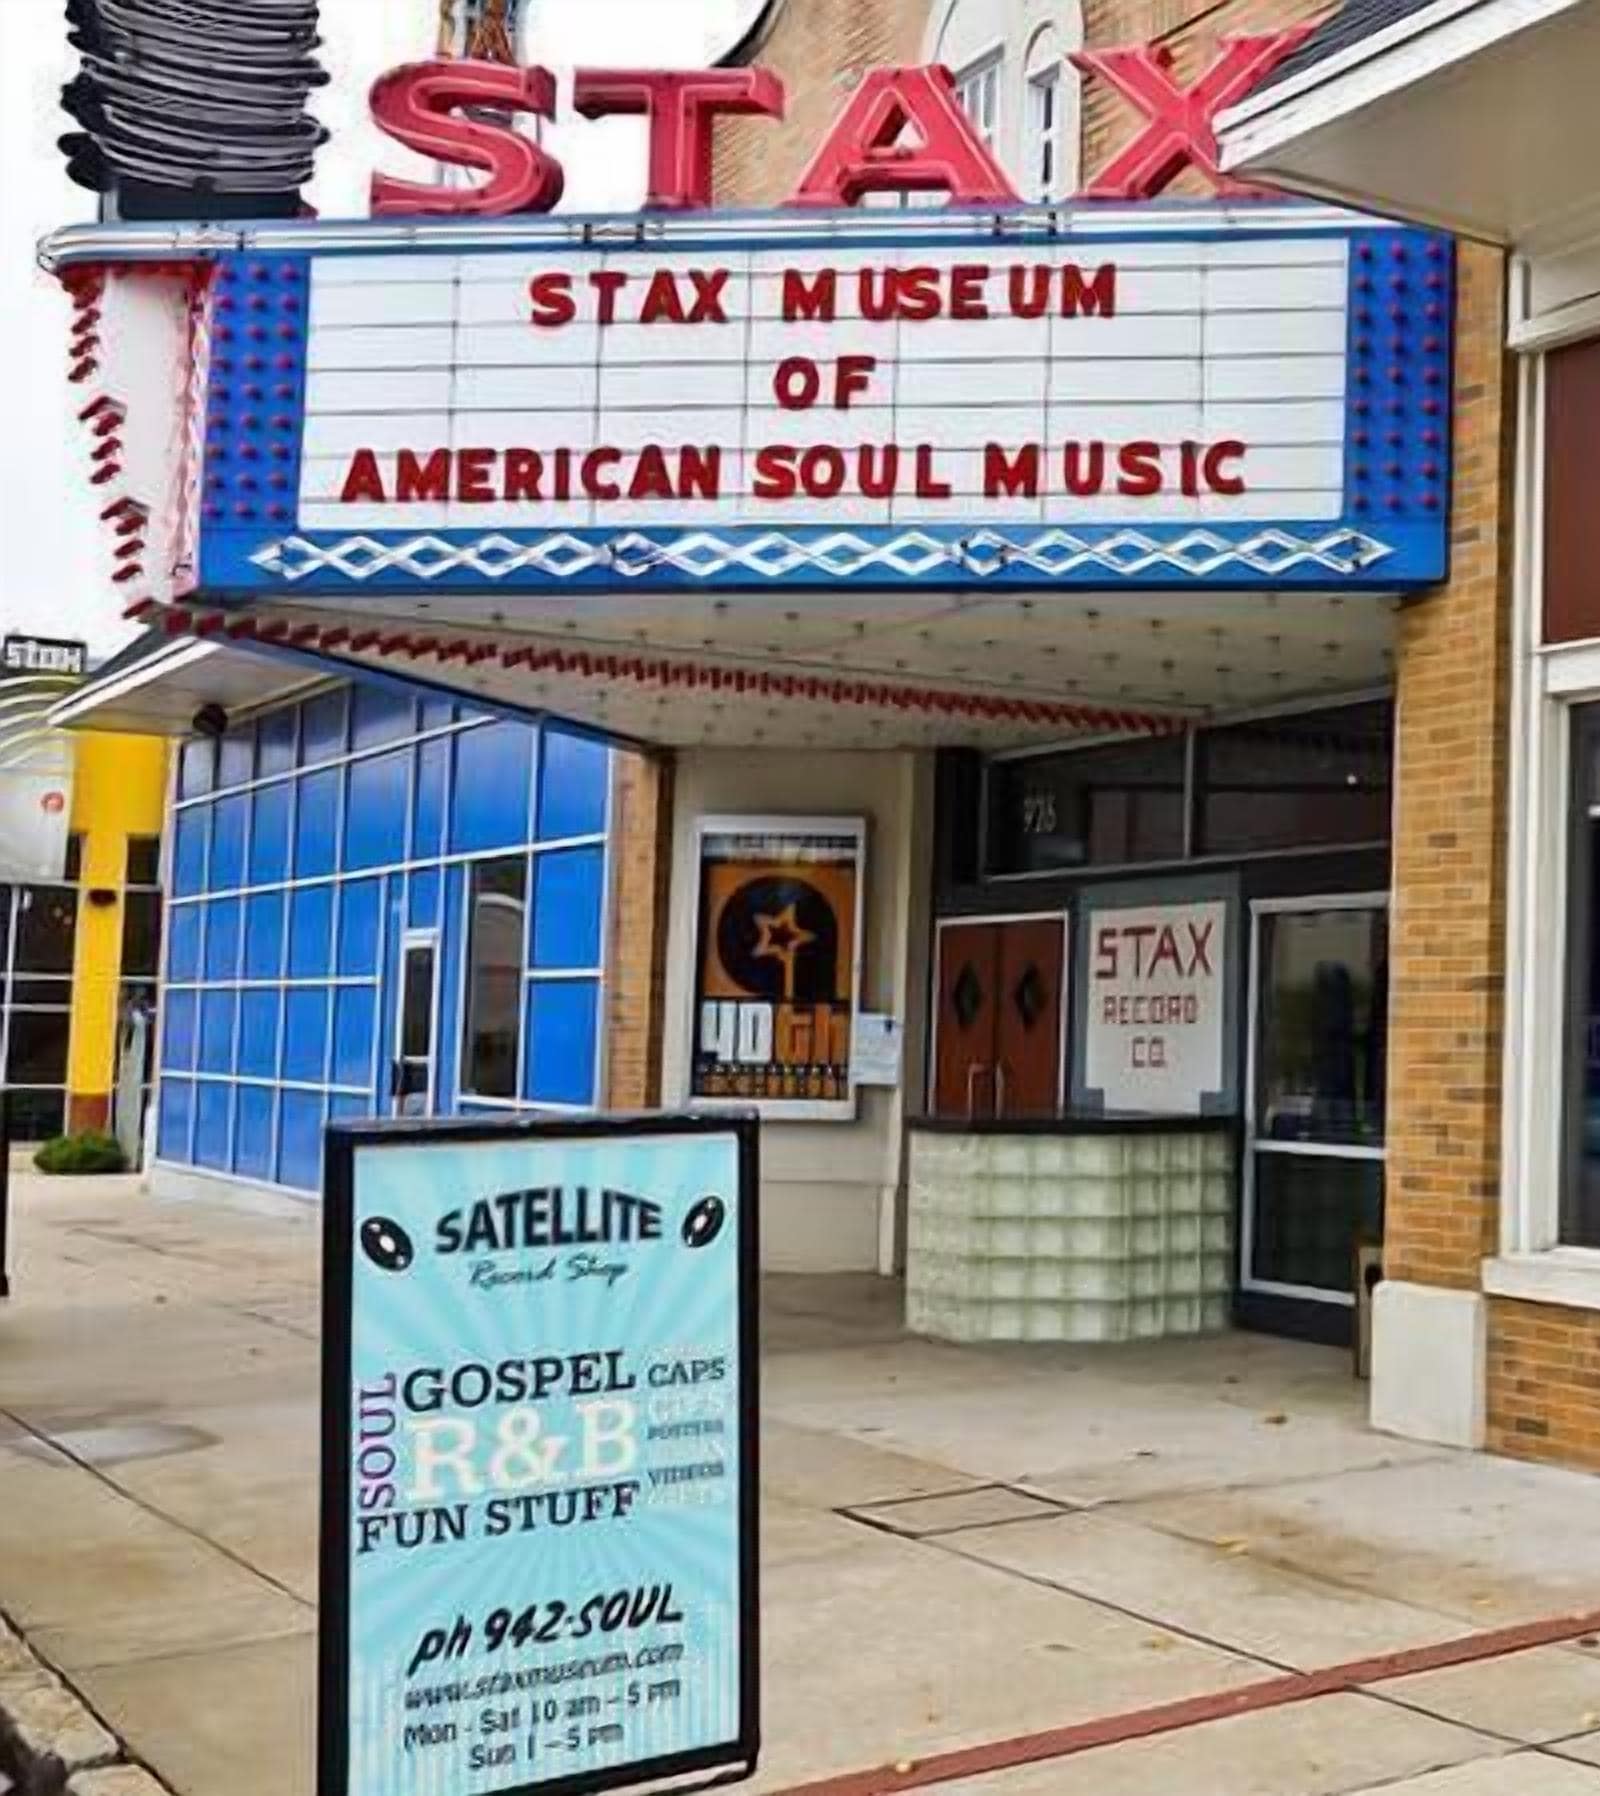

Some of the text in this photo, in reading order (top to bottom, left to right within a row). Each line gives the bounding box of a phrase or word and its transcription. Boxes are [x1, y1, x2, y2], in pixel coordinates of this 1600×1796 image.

[368, 20, 1322, 213] STAX
[529, 263, 1117, 327] STAX MUSEUM
[773, 355, 876, 412] OF
[340, 441, 1247, 503] AMERICAN SOUL MUSIC
[1096, 918, 1213, 979] STAX
[1104, 995, 1199, 1025] RECORD
[436, 1187, 662, 1254] SATELLITE
[403, 1350, 636, 1413] GOSPEL
[647, 1356, 725, 1388] CAPS
[359, 1372, 396, 1510] SOUL
[403, 1400, 638, 1503] R&B
[356, 1480, 640, 1555] FUN STUFF
[406, 1614, 472, 1679] ph
[404, 1722, 457, 1750] Mon
[480, 1705, 521, 1735] Sat
[532, 1698, 557, 1725] 10
[567, 1695, 601, 1718] am
[628, 1680, 641, 1704] 5
[648, 1678, 681, 1704] pm
[468, 1743, 517, 1771] Sun
[588, 1723, 625, 1746] pm
